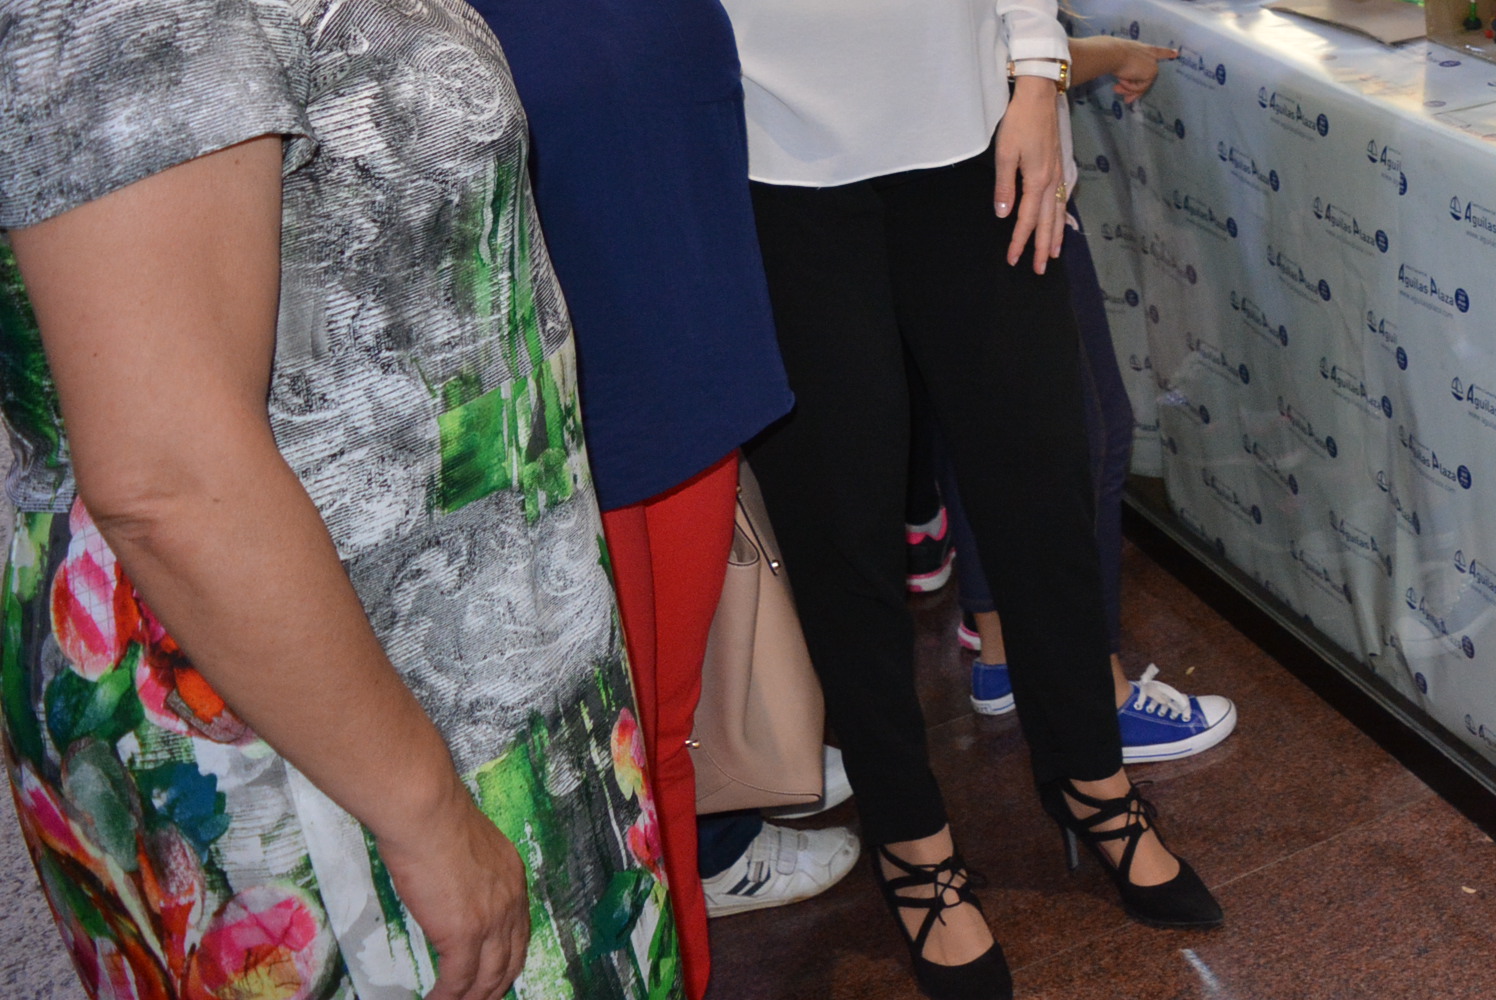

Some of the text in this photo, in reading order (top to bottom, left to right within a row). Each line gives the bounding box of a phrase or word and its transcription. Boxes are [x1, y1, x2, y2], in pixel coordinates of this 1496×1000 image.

[1380, 146, 1400, 173] Aguil
[1398, 263, 1454, 307] Aguilas Plaza
